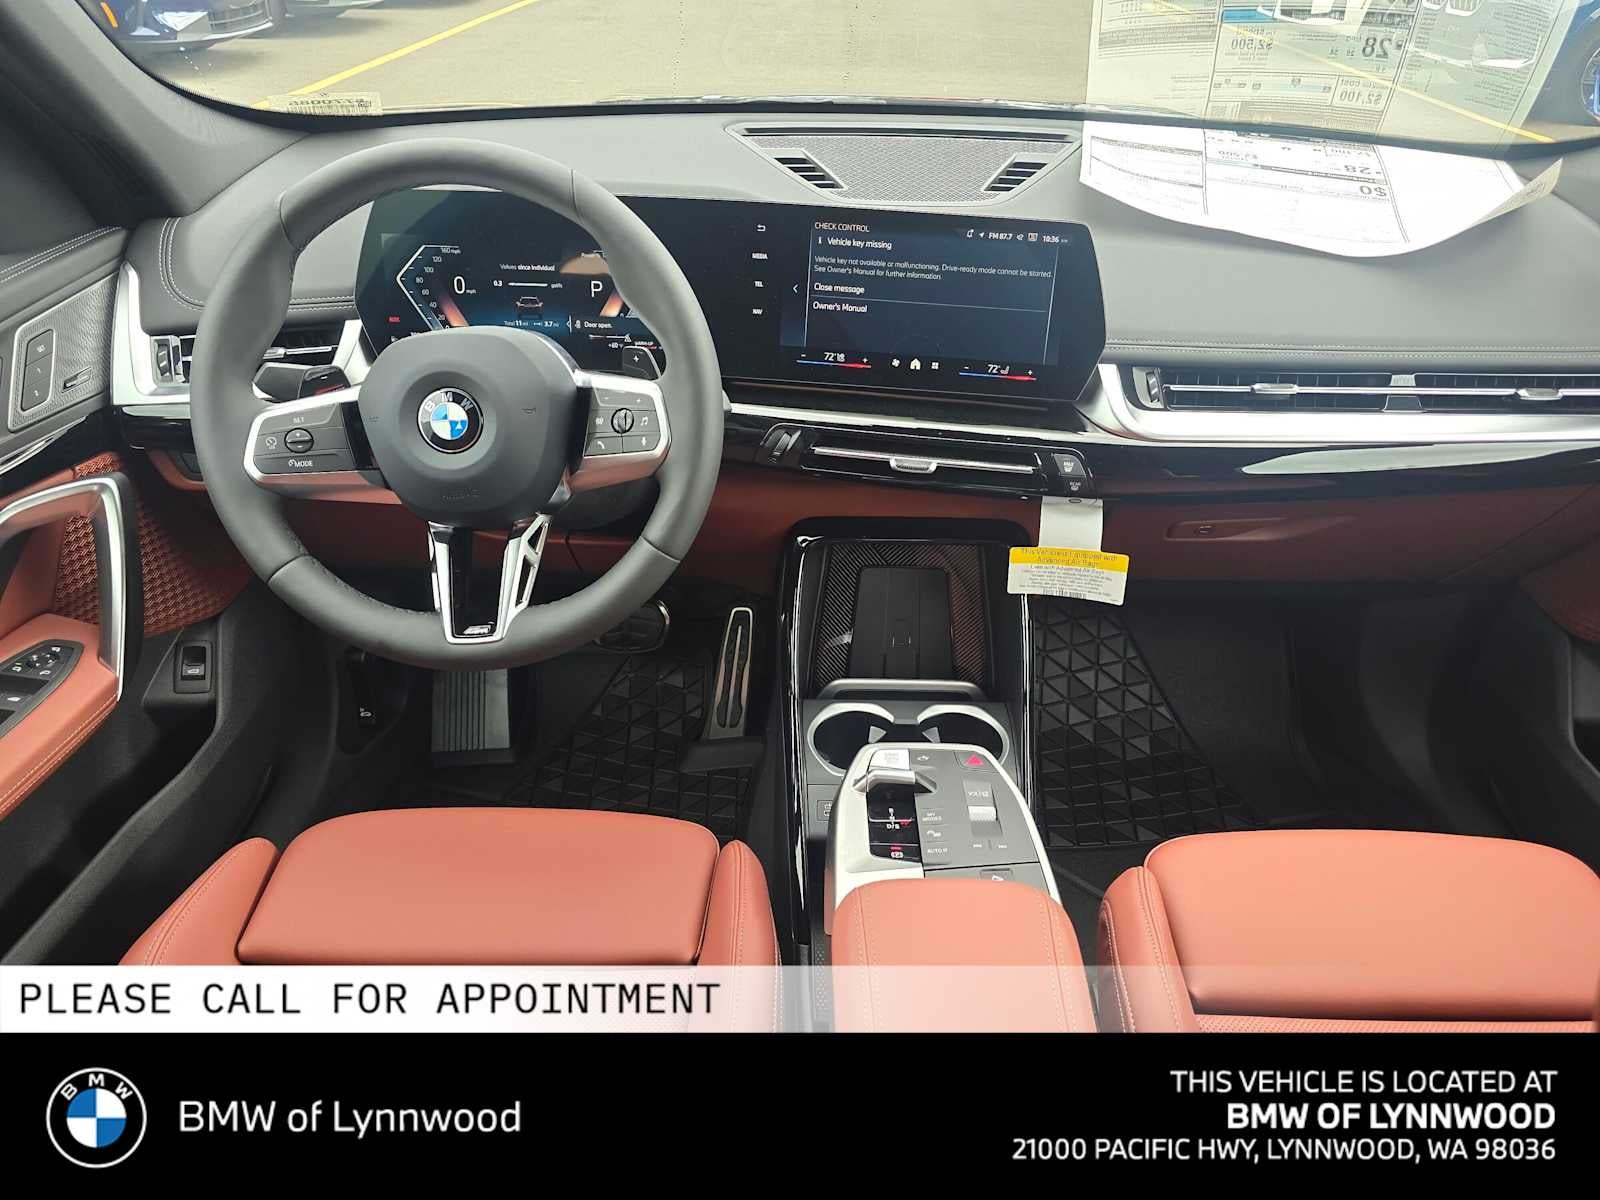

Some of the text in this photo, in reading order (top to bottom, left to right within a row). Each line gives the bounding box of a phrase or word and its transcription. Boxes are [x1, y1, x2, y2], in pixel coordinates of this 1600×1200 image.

[814, 221, 870, 233] CHECK CONTROL
[988, 232, 998, 240] FM
[827, 237, 892, 250] Vehicle key missing
[752, 252, 768, 260] MEDIA
[814, 255, 836, 264] Vehicle
[837, 257, 848, 266] key
[860, 259, 886, 267] available
[941, 264, 978, 273] Drive-ready
[978, 266, 996, 274] mode
[997, 268, 1019, 276] cannot
[827, 266, 852, 274] Owner's
[853, 268, 875, 276] Manual
[885, 270, 906, 278] further
[453, 275, 466, 294] 0
[590, 280, 603, 298] P
[814, 282, 865, 294] Close message
[812, 301, 868, 313] Owner's Manual
[424, 391, 474, 412] BMW
